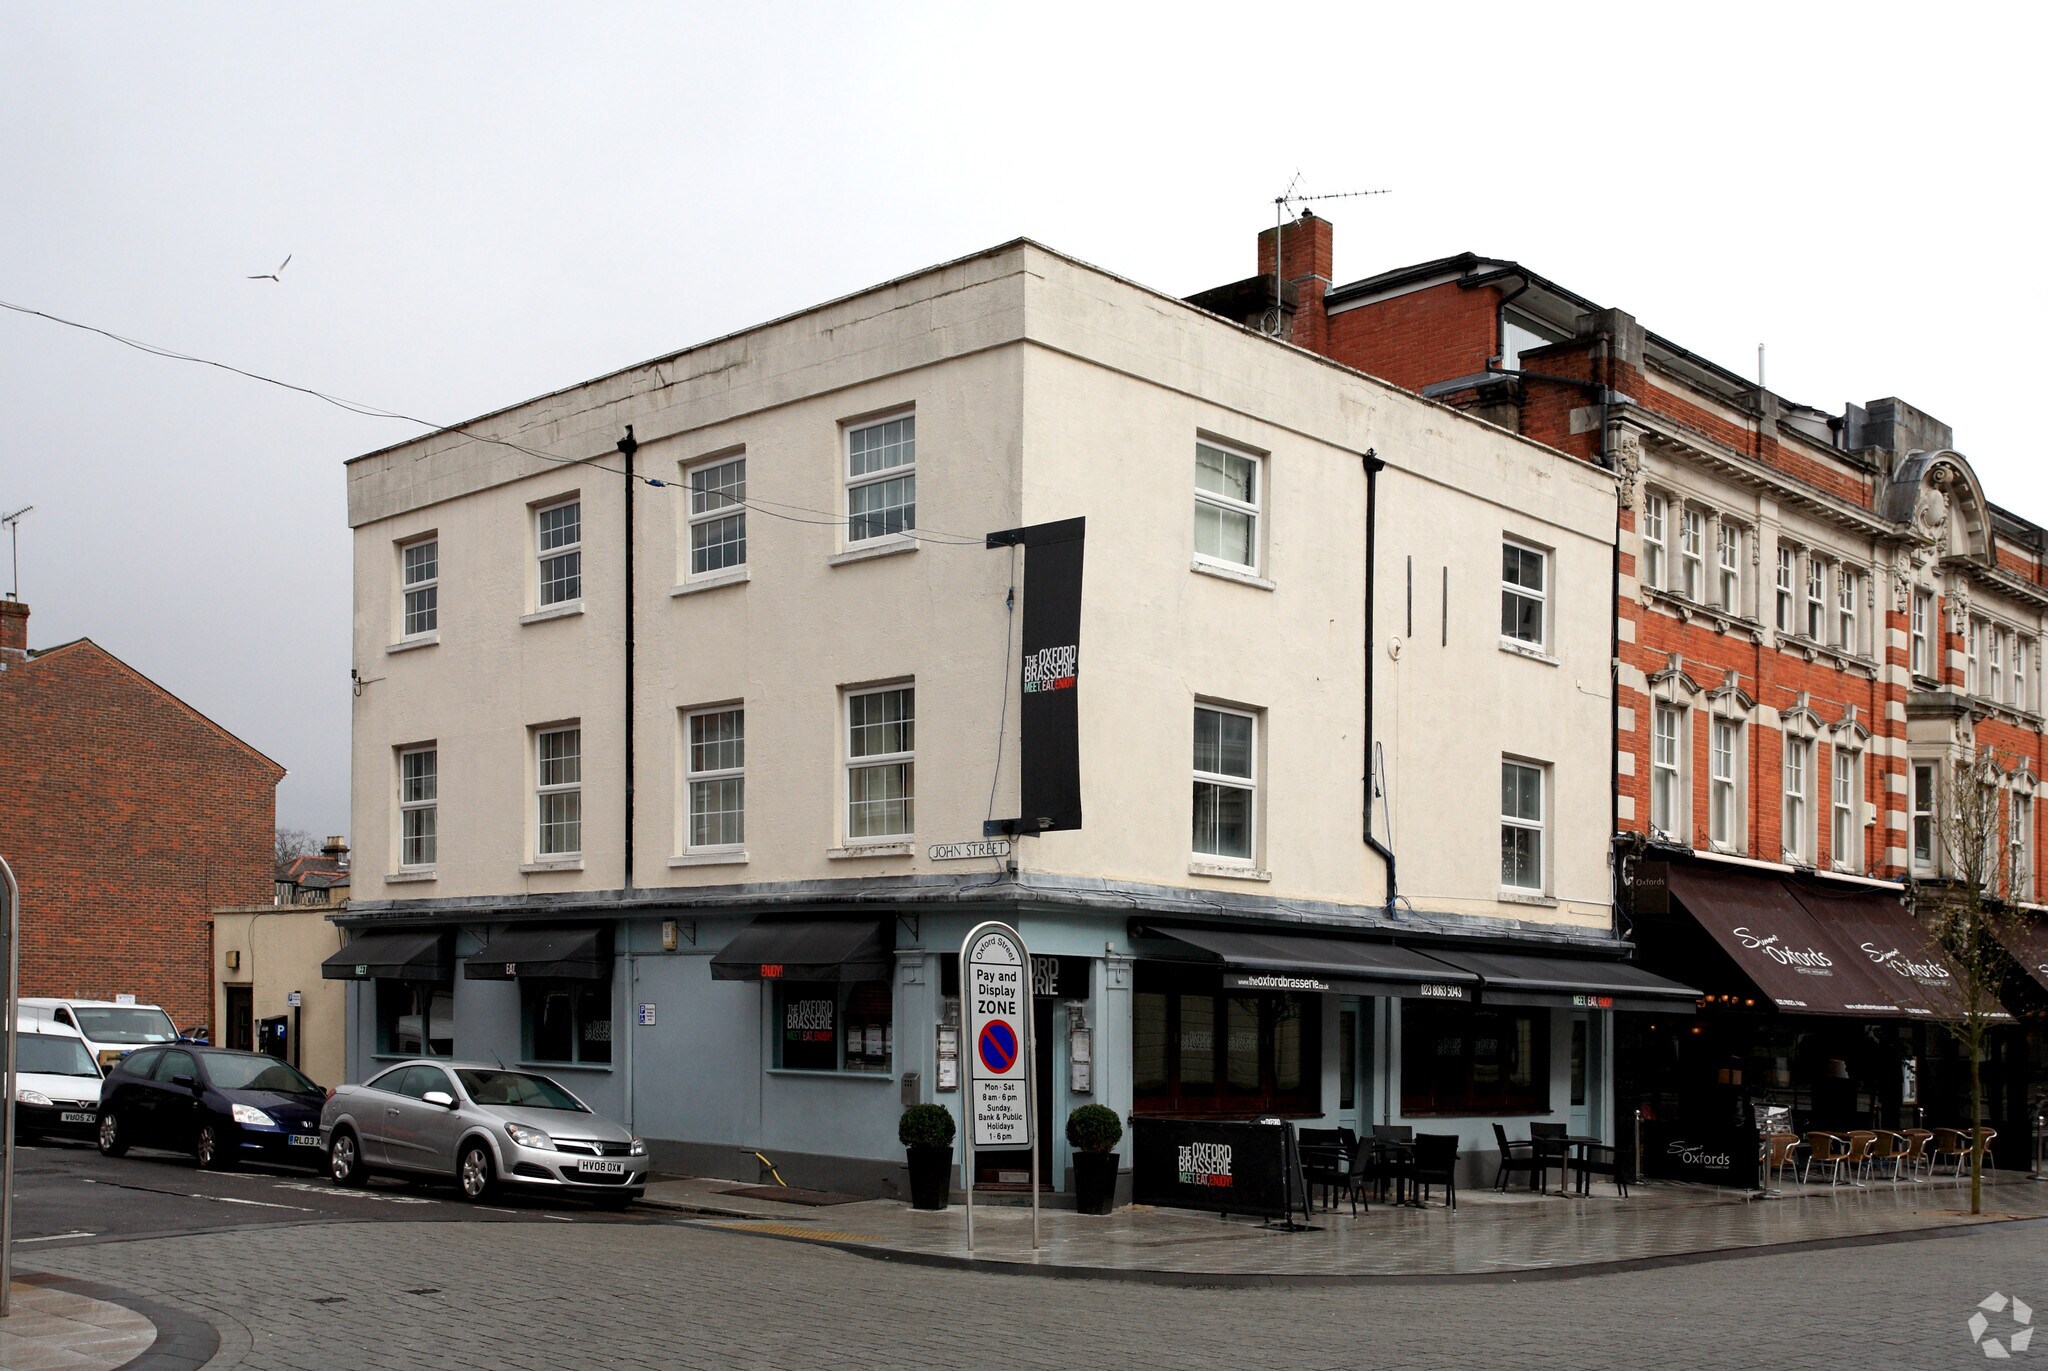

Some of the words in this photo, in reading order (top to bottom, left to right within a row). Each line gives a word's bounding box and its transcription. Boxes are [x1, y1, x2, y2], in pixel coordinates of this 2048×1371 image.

[1025, 655, 1038, 667] THE
[1039, 645, 1076, 666] OXFORD
[1025, 660, 1075, 682] BRASSERIE
[934, 845, 961, 858] JOHN
[966, 842, 1004, 855] STREET
[1636, 878, 1665, 886] Oxfords
[976, 937, 996, 960] Oxford
[997, 938, 1015, 962] Street
[1766, 946, 1832, 967] Oxfords
[761, 965, 783, 977] ENJOY!
[1890, 959, 1949, 977] Oxfords
[977, 969, 995, 983] Pay
[998, 972, 1017, 982] and
[979, 984, 1016, 998] Display
[1421, 983, 1431, 996] 023
[1447, 985, 1462, 998] 5043
[787, 1004, 799, 1015] THE
[800, 1000, 833, 1016] OXFORD
[978, 1001, 1016, 1015] ZONE
[787, 1014, 833, 1029] BRASSERIE
[277, 1025, 285, 1036] P
[987, 1123, 1014, 1131] Holidays
[294, 1136, 315, 1144] RL03
[1179, 1146, 1192, 1158] THE
[1192, 1142, 1232, 1161] OXFORD
[1682, 1152, 1730, 1165] Oxfords
[582, 1161, 606, 1171] HV08
[1179, 1156, 1232, 1175] BRASSERIE
[1210, 1175, 1233, 1187] ENJOY!
